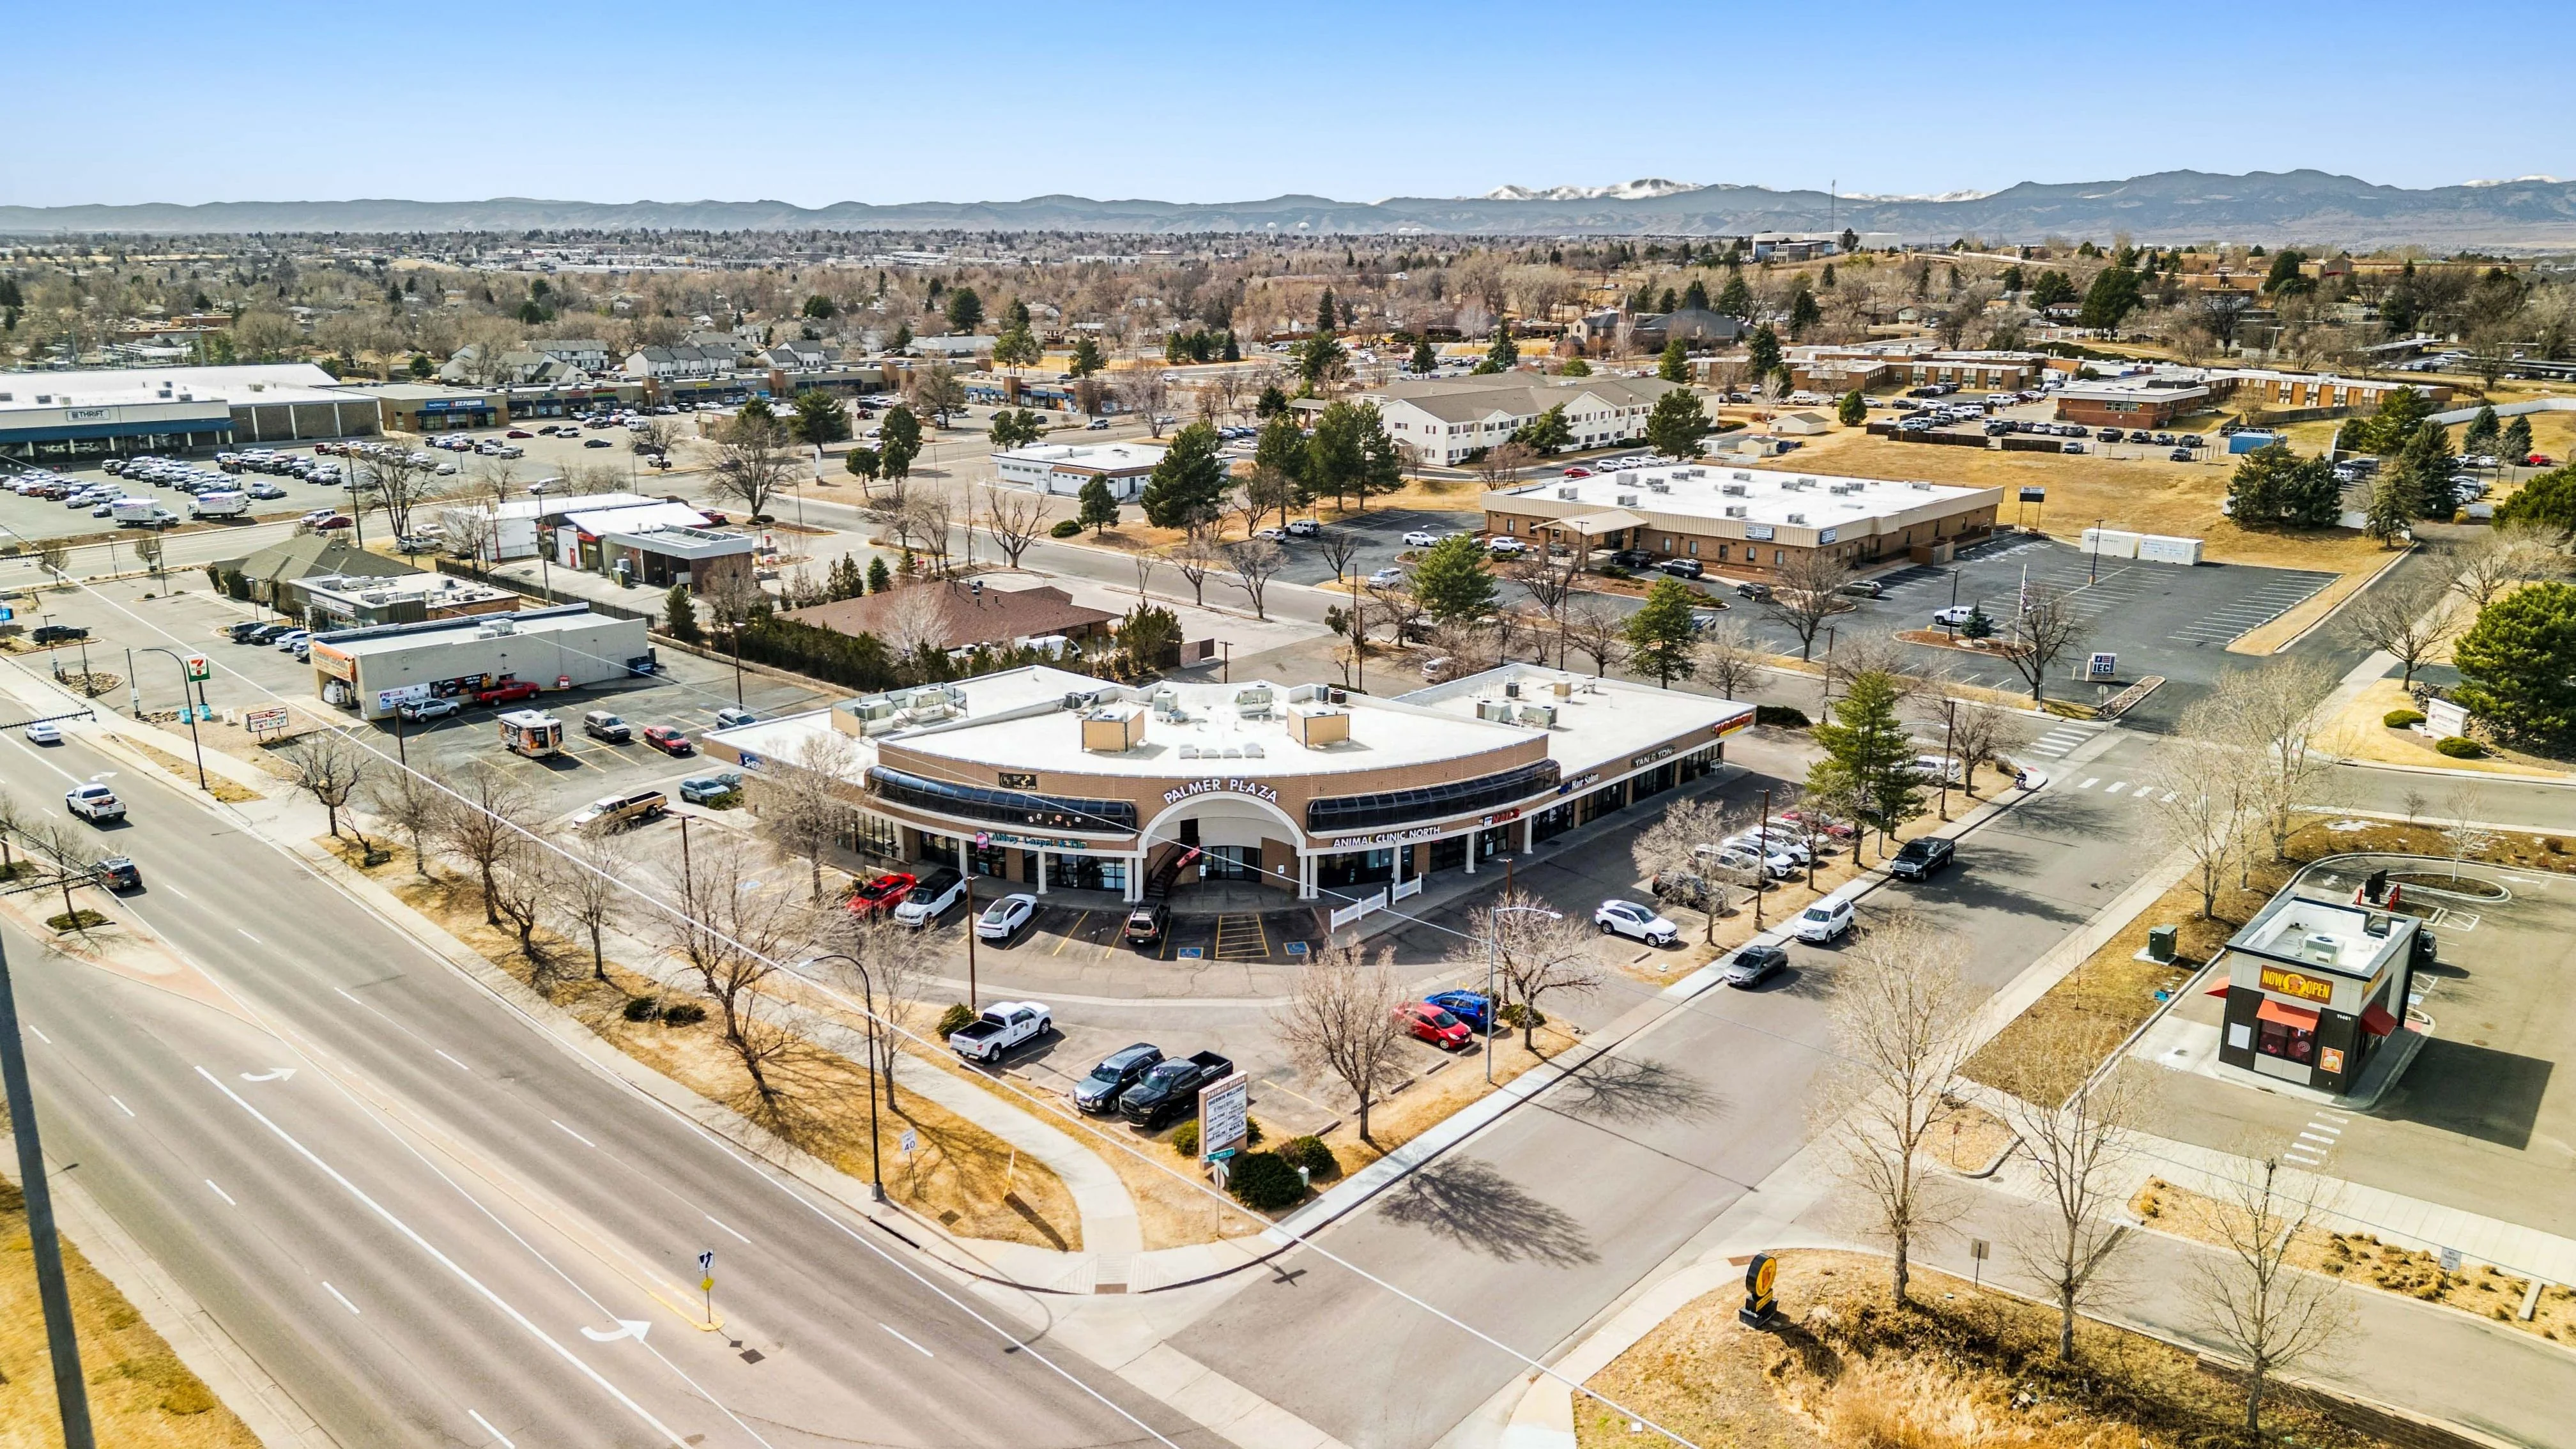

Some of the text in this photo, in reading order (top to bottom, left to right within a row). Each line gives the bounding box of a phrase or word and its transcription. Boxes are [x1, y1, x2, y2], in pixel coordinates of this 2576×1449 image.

[191, 659, 204, 675] 7
[2093, 664, 2110, 672] IEC
[1636, 755, 1650, 767] TAN
[1657, 747, 1675, 759] TON
[1572, 779, 1584, 791] Hair
[1584, 773, 1599, 784] Salon
[1163, 779, 1277, 804] PALMER PLAZA
[1492, 808, 1520, 824] NAILS
[992, 832, 1086, 849] Abbey Carpet & Tile
[1333, 826, 1441, 848] ANIMAL CLINIC NORTH
[2262, 970, 2285, 987] NOW
[2306, 981, 2330, 999] OPEN
[1208, 1094, 1225, 1106] SHERWIN
[1226, 1085, 1245, 1097] WILLIAMS
[904, 1140, 916, 1150] 40
